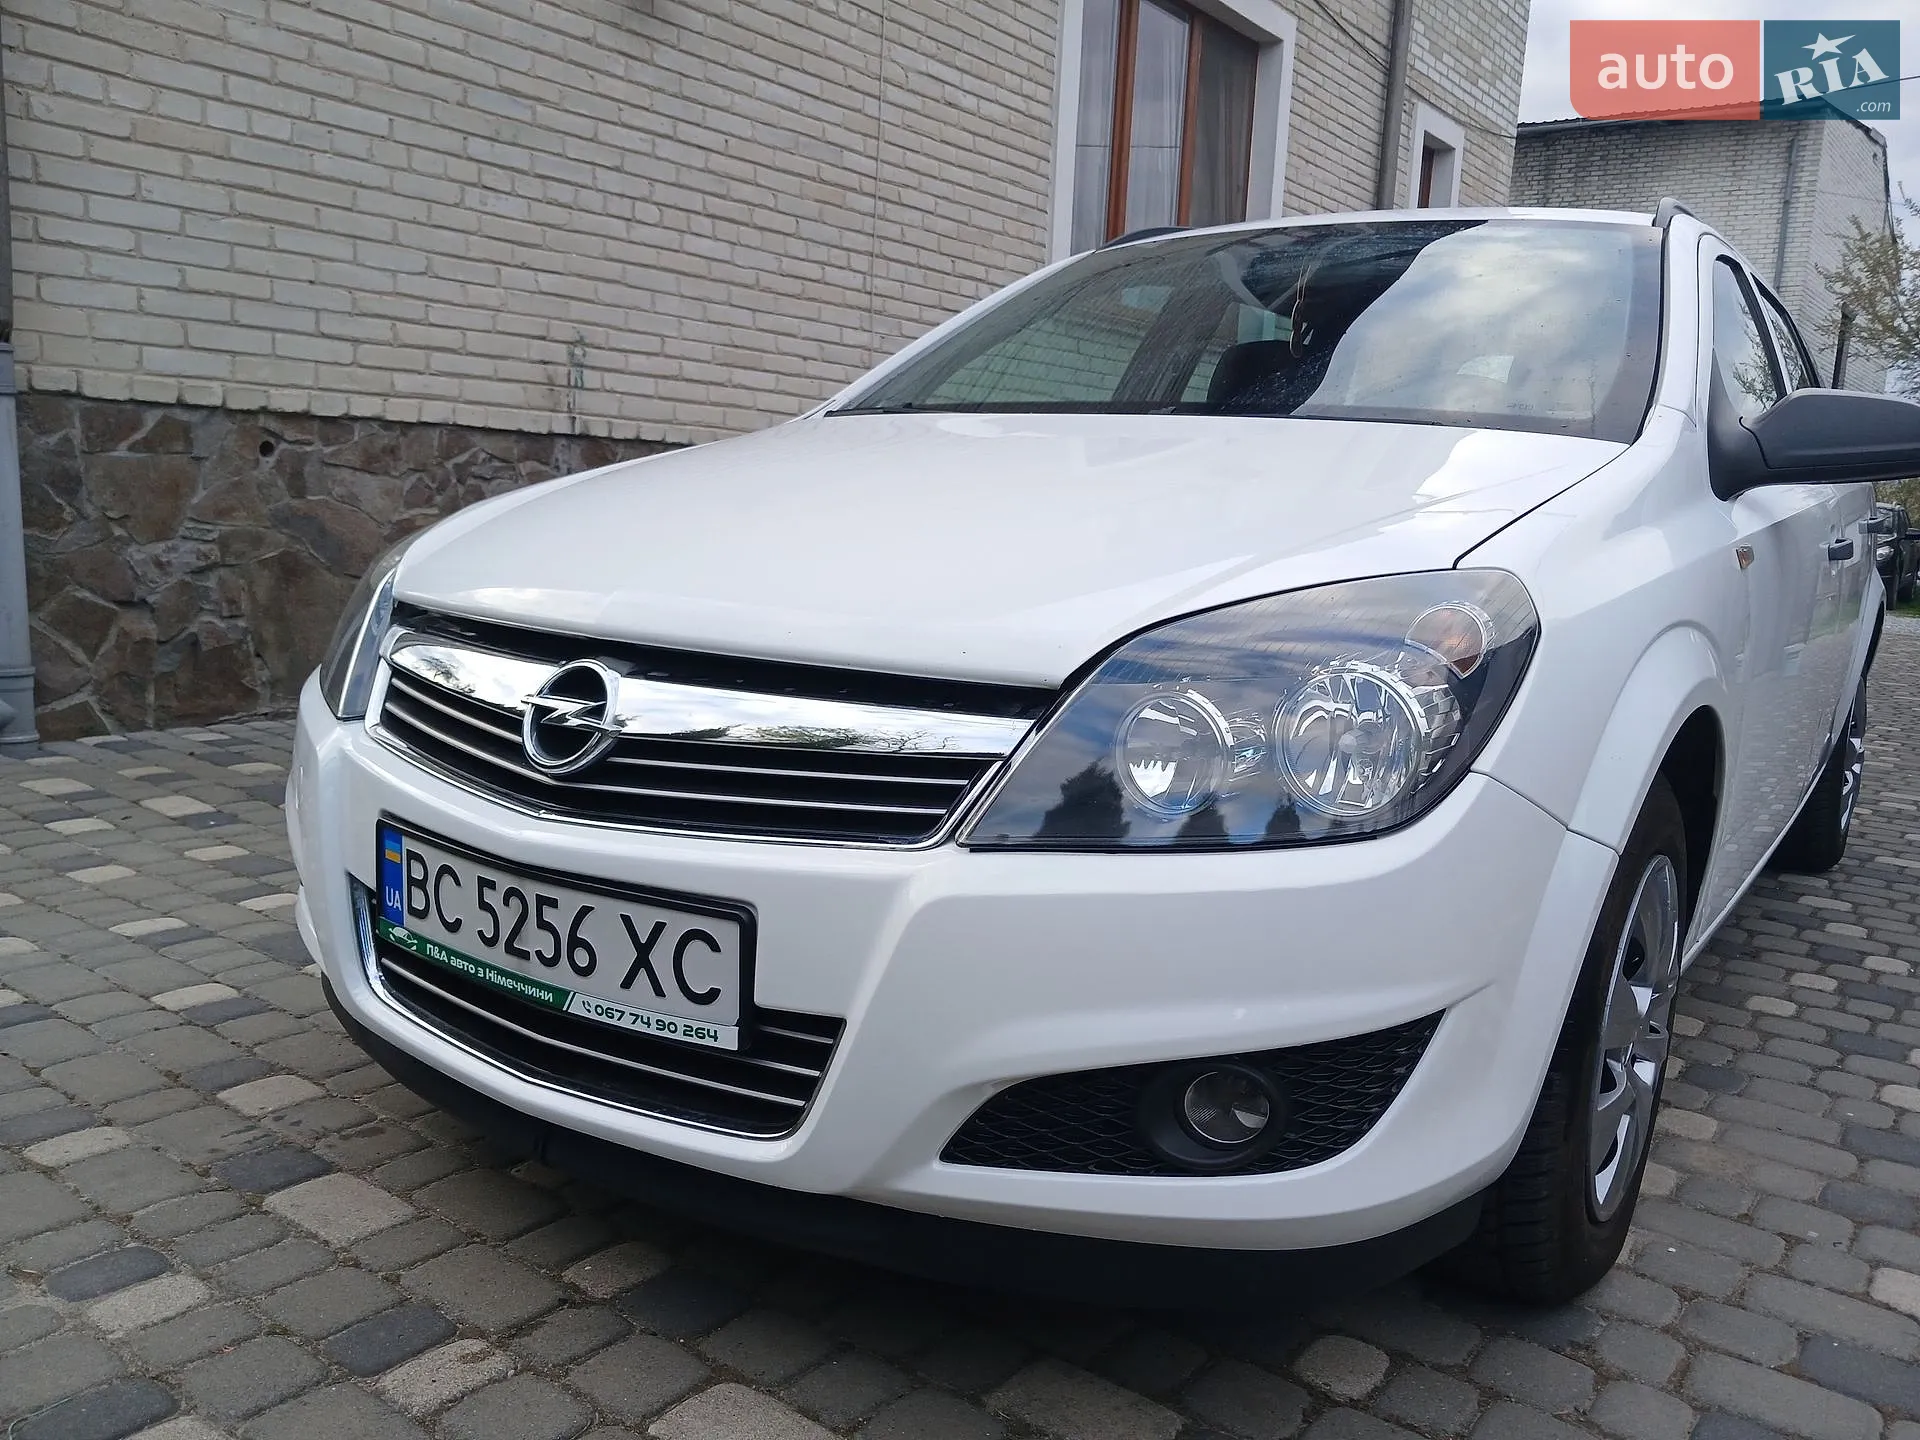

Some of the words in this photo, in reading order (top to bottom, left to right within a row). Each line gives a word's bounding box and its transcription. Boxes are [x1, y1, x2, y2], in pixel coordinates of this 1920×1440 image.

[385, 886, 402, 911] UA
[406, 848, 463, 934] BC
[476, 874, 597, 977] 5256
[619, 913, 722, 1005] XC
[450, 955, 476, 975] авто
[485, 967, 554, 1003] Німеччини
[594, 1004, 626, 1021] 067
[628, 1012, 652, 1029] 74
[655, 1018, 679, 1034] 90
[682, 1024, 719, 1043] 264
